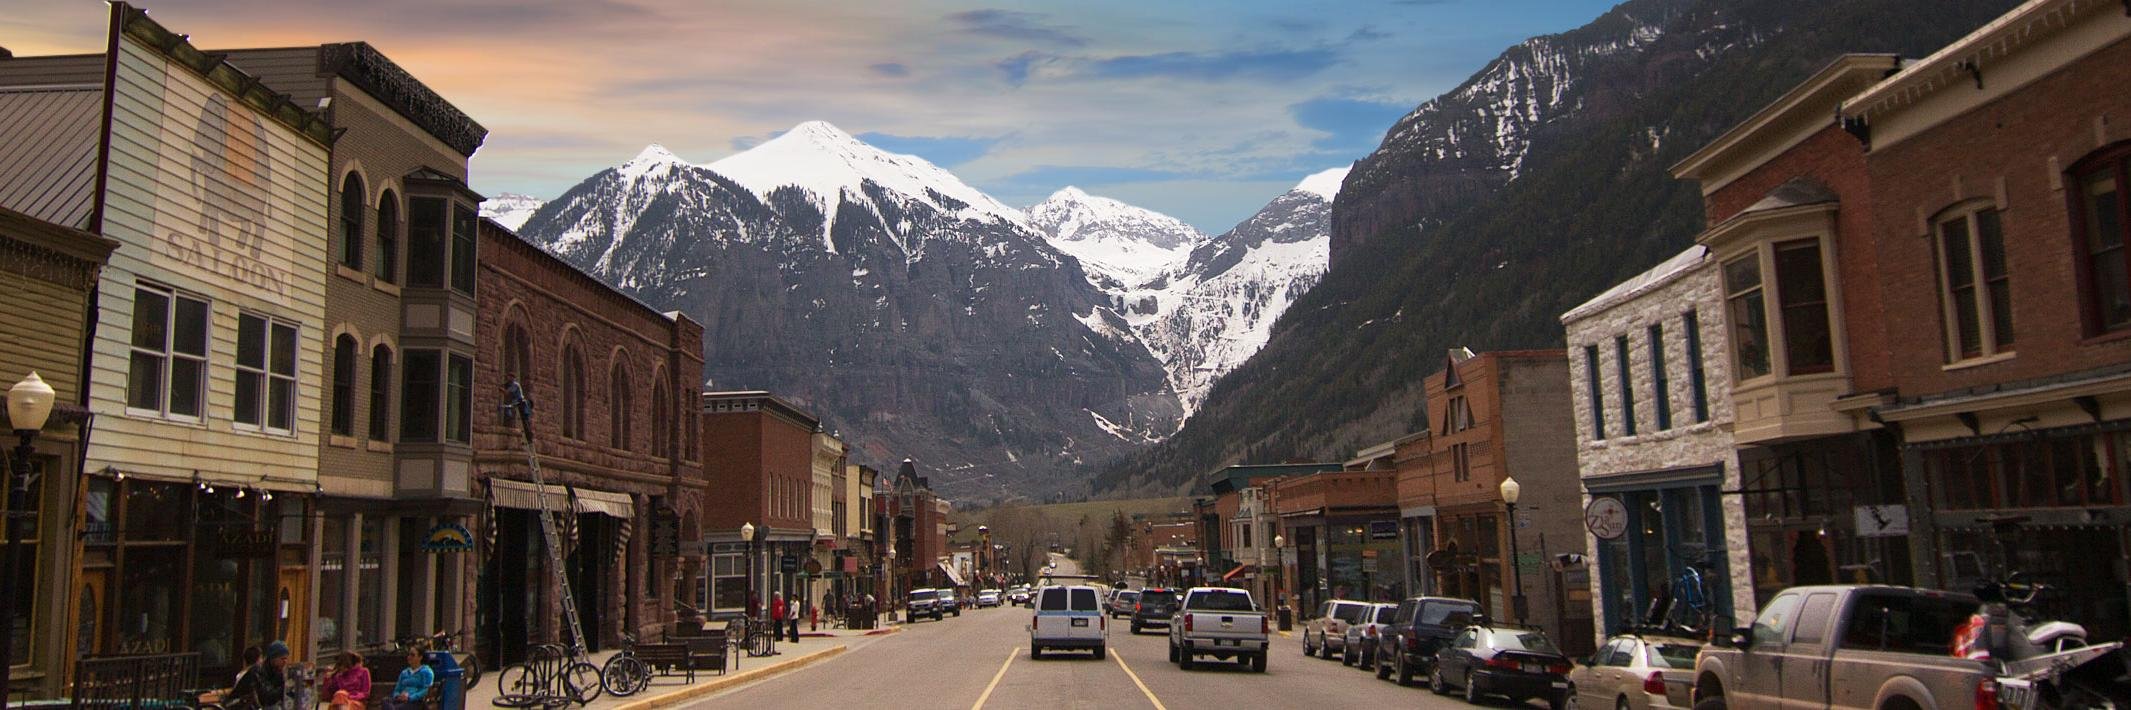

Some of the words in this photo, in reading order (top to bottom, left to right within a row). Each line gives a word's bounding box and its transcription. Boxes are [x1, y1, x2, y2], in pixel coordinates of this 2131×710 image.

[165, 232, 286, 301] SALOON
[218, 533, 274, 546] AZADI
[119, 639, 171, 655] AZADI
